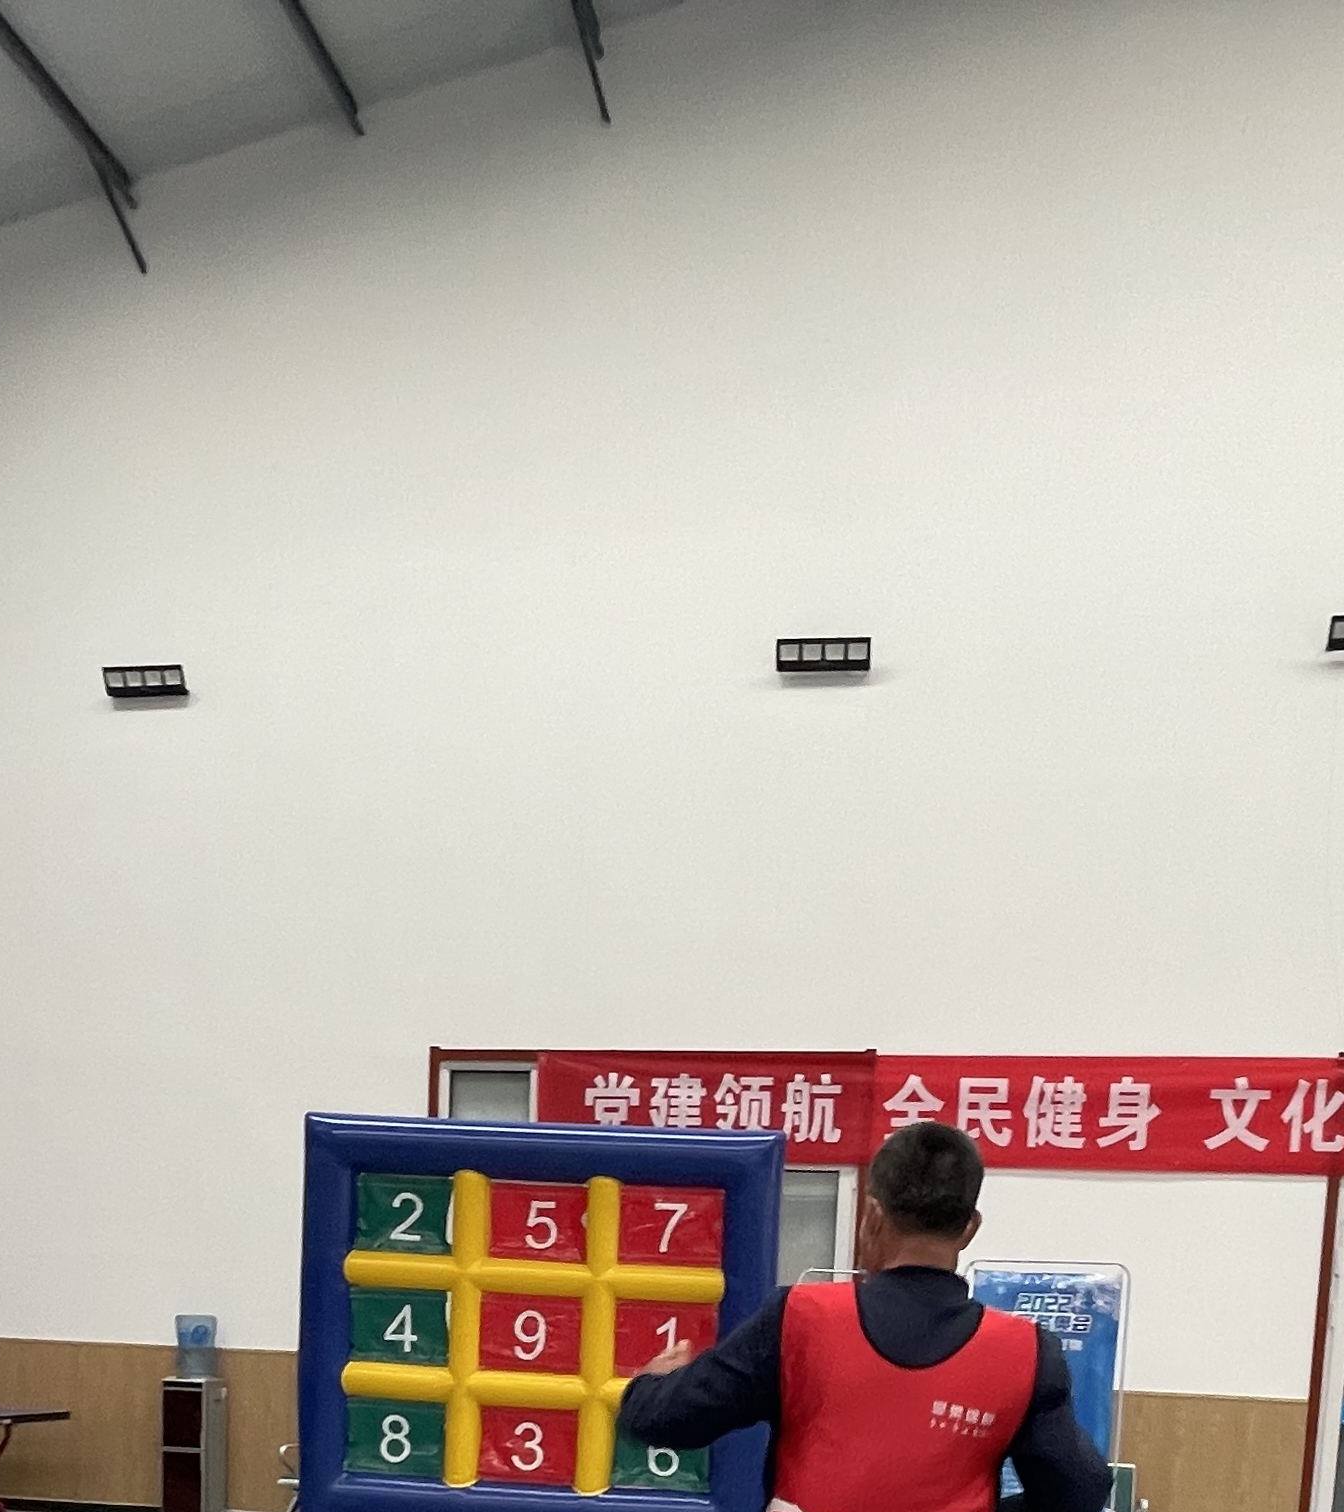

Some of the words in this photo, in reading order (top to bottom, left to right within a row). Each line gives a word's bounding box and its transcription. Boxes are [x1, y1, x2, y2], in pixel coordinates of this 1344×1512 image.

[584, 1072, 842, 1143] 党建领航
[882, 1073, 1163, 1151] 全民健身
[389, 1192, 424, 1242] 2
[524, 1200, 558, 1249] 5
[654, 1202, 688, 1253] 7
[383, 1304, 418, 1353] 4
[513, 1310, 547, 1361] 9
[656, 1316, 677, 1350] 1
[1014, 1293, 1074, 1313] 2022
[379, 1414, 411, 1463] 8
[510, 1422, 544, 1471] 3
[647, 1447, 679, 1477] 6
